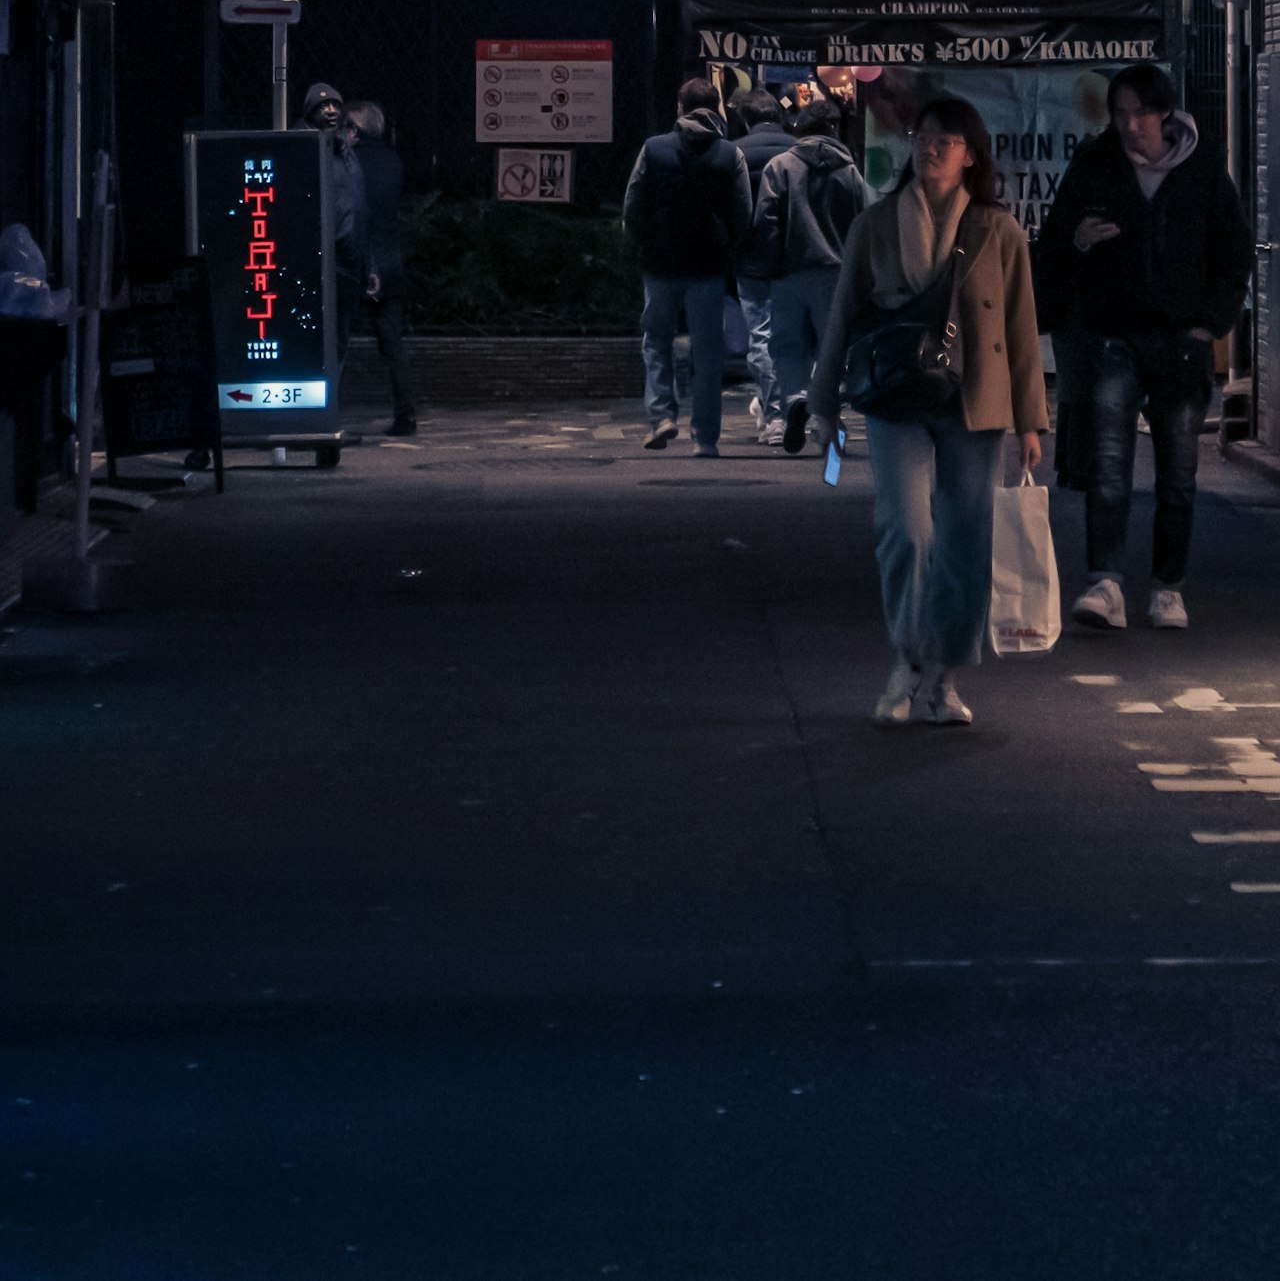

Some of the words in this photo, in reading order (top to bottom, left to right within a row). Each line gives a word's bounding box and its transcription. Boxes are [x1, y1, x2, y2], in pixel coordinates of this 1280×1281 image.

[698, 29, 749, 62] NO
[750, 35, 782, 47] TAX
[827, 42, 926, 64] DRINK'S
[935, 36, 1010, 62] ¥500
[750, 47, 817, 63] CHARGE
[244, 186, 277, 340] TORAJI
